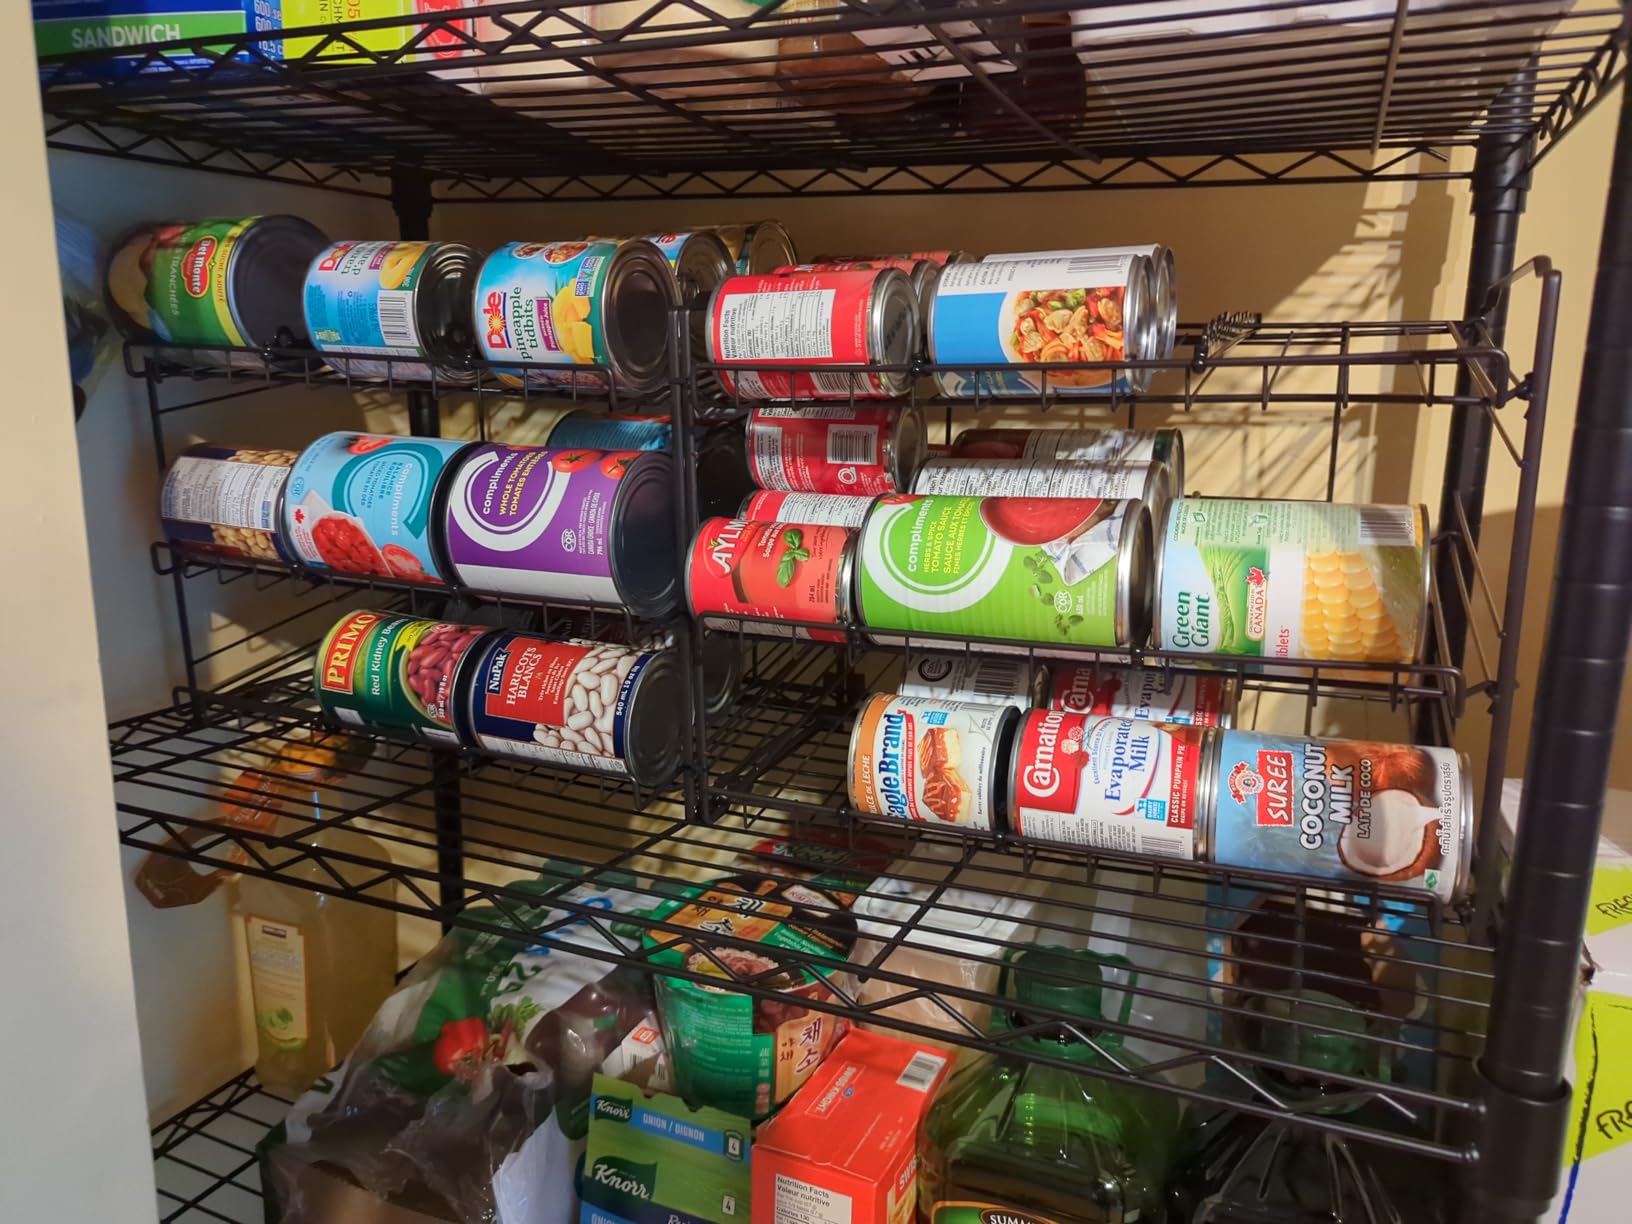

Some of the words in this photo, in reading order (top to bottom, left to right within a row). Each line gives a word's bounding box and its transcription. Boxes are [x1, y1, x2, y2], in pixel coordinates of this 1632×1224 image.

[71, 23, 181, 48] SANDWICH
[198, 239, 212, 256] Del
[192, 257, 205, 293] Monte
[482, 291, 507, 349] Dole
[510, 286, 533, 360] pineapple
[523, 298, 538, 349] tidbits
[546, 320, 556, 349] Pineapple
[386, 463, 403, 495] BALANCE
[482, 452, 518, 515] compliments
[499, 483, 513, 515] WHOLE
[508, 452, 536, 483] TOMATOES
[392, 462, 413, 535] compliments
[510, 477, 526, 516] TOMATES
[907, 499, 934, 572] compliments
[937, 506, 952, 532] SAUCE
[948, 521, 959, 538] AUX
[763, 538, 775, 558] Soupe
[923, 548, 931, 572] HERBS
[927, 521, 937, 541] SPICE
[932, 532, 944, 573] TOMATO
[956, 524, 966, 550] HERBES
[943, 540, 954, 574] SAUCE
[953, 551, 961, 574] FINES
[382, 618, 408, 636] Beans
[1172, 591, 1191, 648] Green
[1191, 595, 1211, 648] Giant
[1254, 589, 1264, 634] CANADA
[327, 613, 376, 685] PRIMO
[372, 636, 388, 673] Kidney
[1276, 627, 1290, 658] iblets
[372, 674, 381, 696] Red
[488, 653, 507, 691] NuPak
[506, 646, 536, 704] HARICOTS
[517, 653, 543, 698] BLANCS
[623, 680, 631, 688] 19
[615, 701, 625, 716] 540
[620, 688, 628, 701] mL
[878, 713, 905, 776] Brand
[1091, 737, 1101, 756] Source
[1129, 735, 1150, 773] Milk
[861, 755, 872, 785] LECHE
[1173, 757, 1184, 790] PUMPKIN
[1358, 758, 1373, 795] COCO
[1265, 754, 1290, 822] SUREE
[1300, 743, 1328, 850] COCONUT
[1329, 764, 1355, 825] MILK
[1358, 796, 1371, 811] DE
[1170, 791, 1180, 824] CLASSIC
[1356, 811, 1371, 839] LAIT
[596, 1098, 631, 1120] Knorr
[643, 1112, 667, 1131] ONION
[674, 1122, 705, 1143] OIGNON
[731, 1141, 737, 1152] 4
[594, 1163, 650, 1201] Knorr
[777, 1175, 808, 1192] Nutrition
[809, 1185, 830, 1199] Facts
[777, 1184, 799, 1198] Valeur
[800, 1192, 831, 1208] nutritive
[726, 1200, 732, 1212] 4
[776, 1205, 799, 1219] Calories
